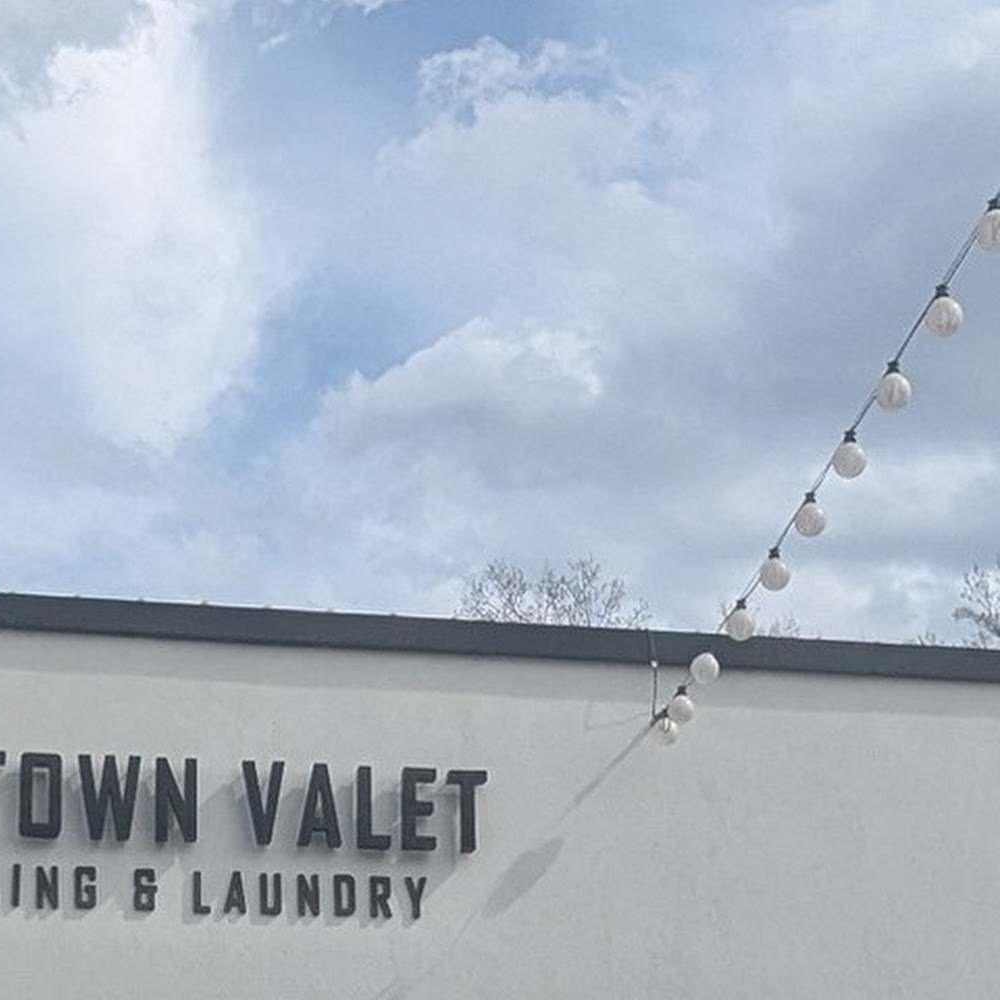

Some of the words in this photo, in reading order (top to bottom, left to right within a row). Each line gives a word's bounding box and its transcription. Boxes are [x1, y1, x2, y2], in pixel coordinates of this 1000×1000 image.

[241, 760, 487, 854] VALET
[133, 867, 158, 912] &
[192, 870, 427, 920] LAUNDRY
